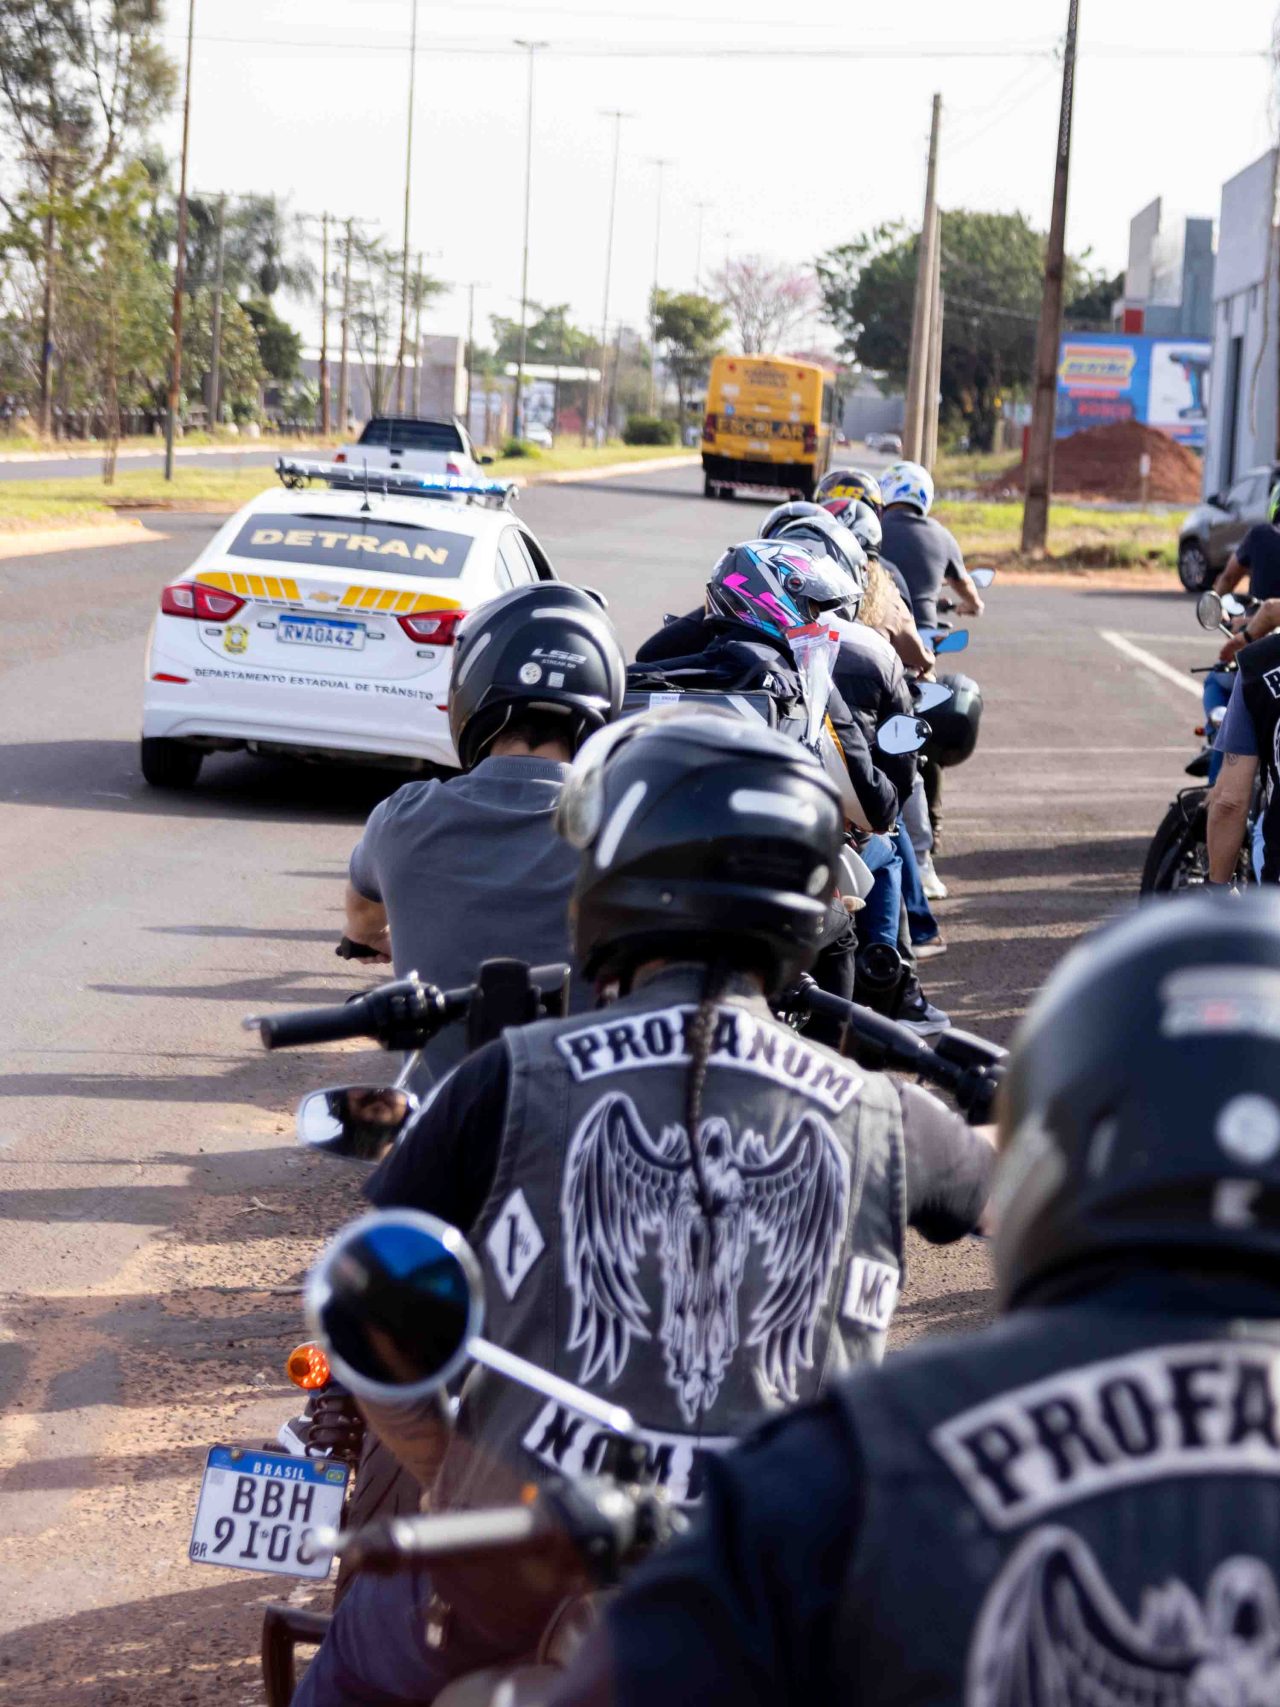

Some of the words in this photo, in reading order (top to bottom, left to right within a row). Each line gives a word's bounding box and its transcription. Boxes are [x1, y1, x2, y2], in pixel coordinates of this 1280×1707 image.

[718, 417, 804, 440] ESCOLAR
[251, 529, 449, 565] DETRAN
[194, 668, 286, 684] DEPARTAMENTO
[290, 676, 350, 690] ESTADUAL
[355, 683, 368, 692] DE
[375, 684, 434, 701] TRÂNSITO
[859, 1262, 892, 1321] MC
[254, 1462, 305, 1480] BRASIL
[232, 1475, 315, 1523] BBH
[191, 1541, 208, 1557] BR
